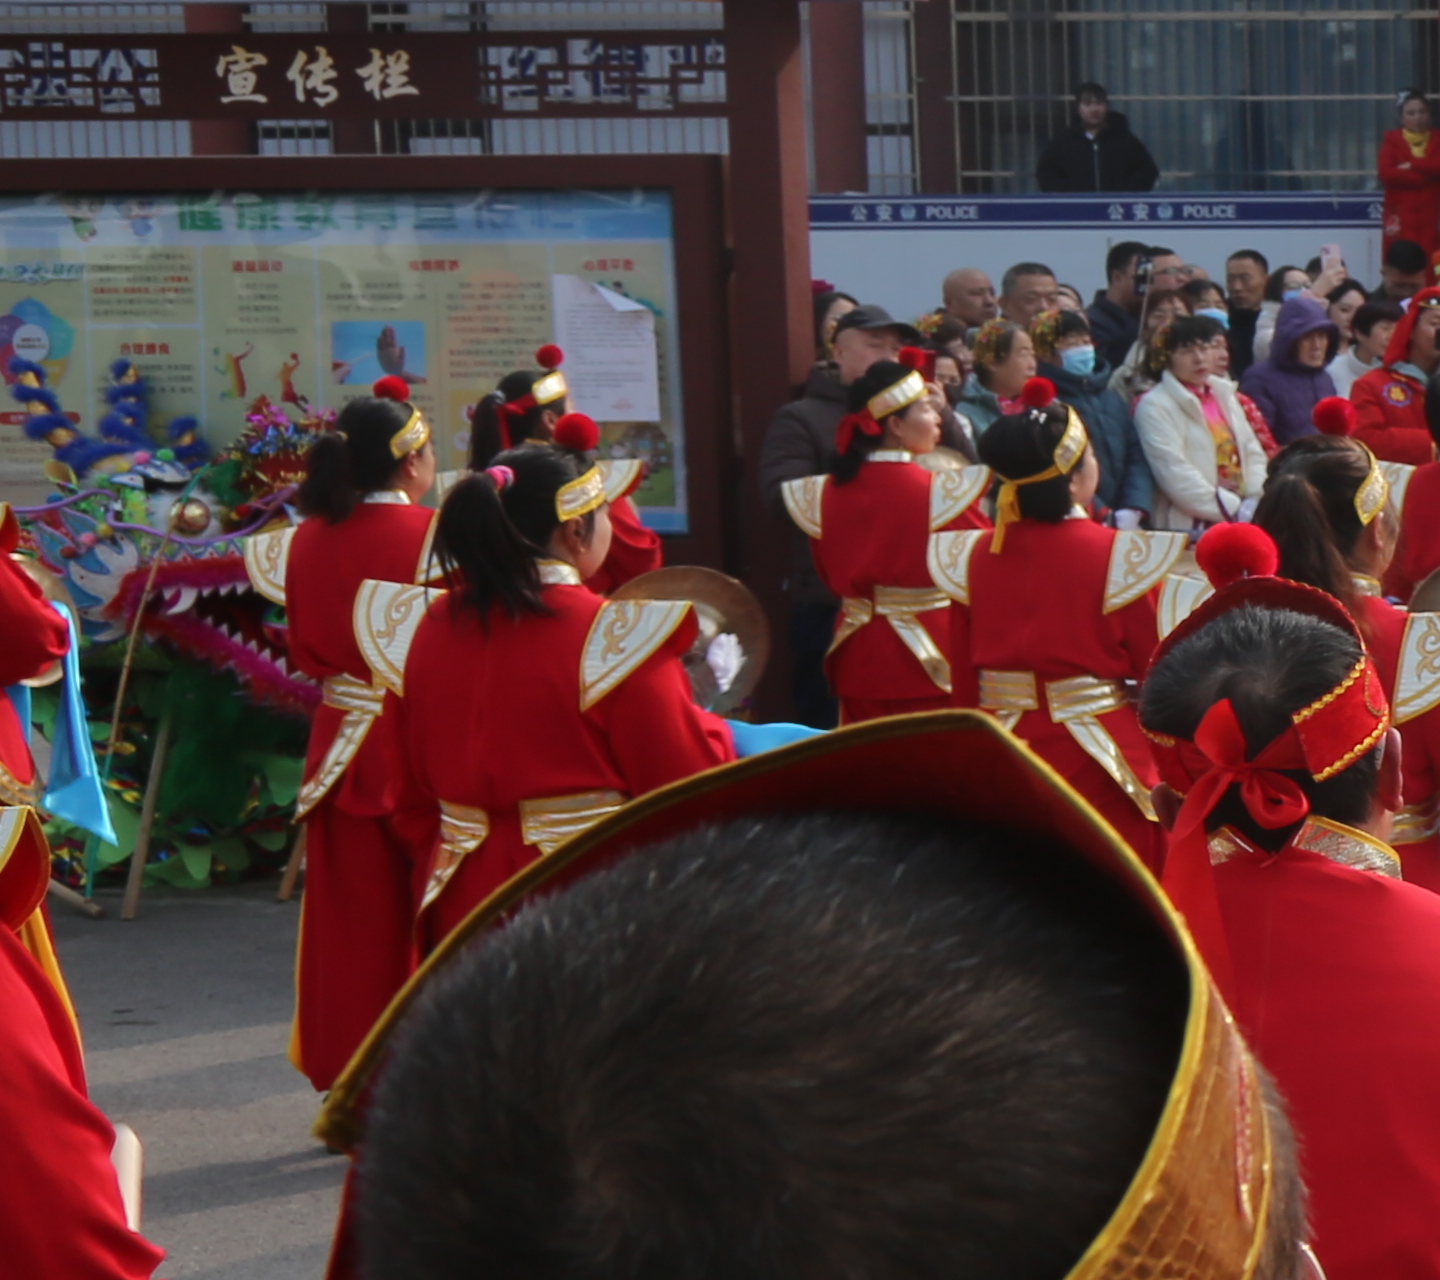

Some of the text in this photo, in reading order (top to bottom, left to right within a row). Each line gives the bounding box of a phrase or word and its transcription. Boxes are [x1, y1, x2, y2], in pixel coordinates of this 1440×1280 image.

[215, 45, 420, 108] 宣传栏
[850, 204, 979, 221] 公安 POLICE
[1107, 203, 1238, 220] 公安 POLICE
